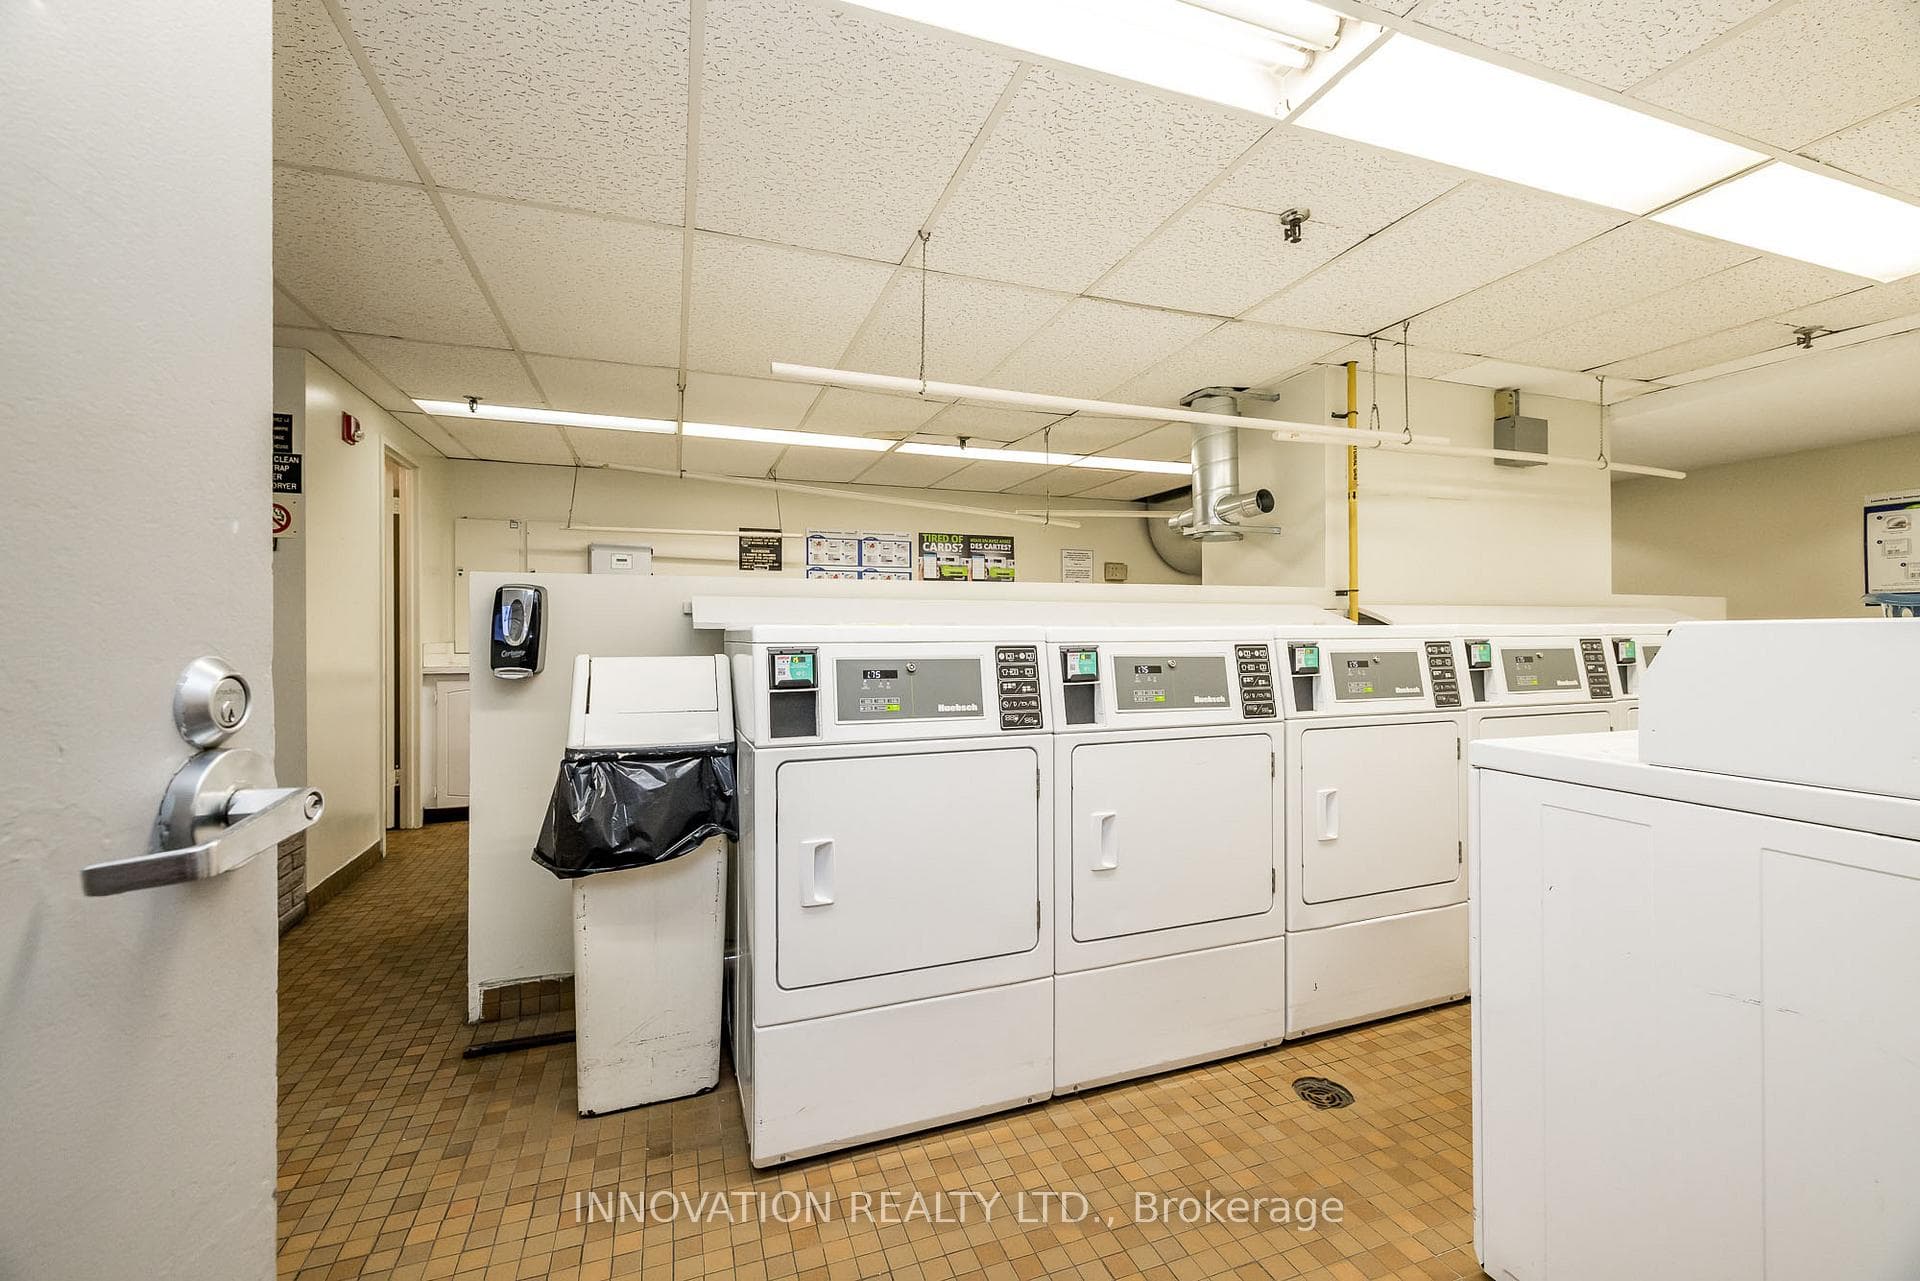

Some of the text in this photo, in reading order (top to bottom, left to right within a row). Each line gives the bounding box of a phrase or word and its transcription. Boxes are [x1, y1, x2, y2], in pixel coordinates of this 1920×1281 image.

[273, 455, 299, 464] CLEAN
[274, 464, 289, 472] RAP
[922, 534, 963, 543] TIRED OF
[922, 542, 963, 552] CARDS?
[983, 543, 1011, 551] CARTES?
[938, 704, 978, 712] Huebsch
